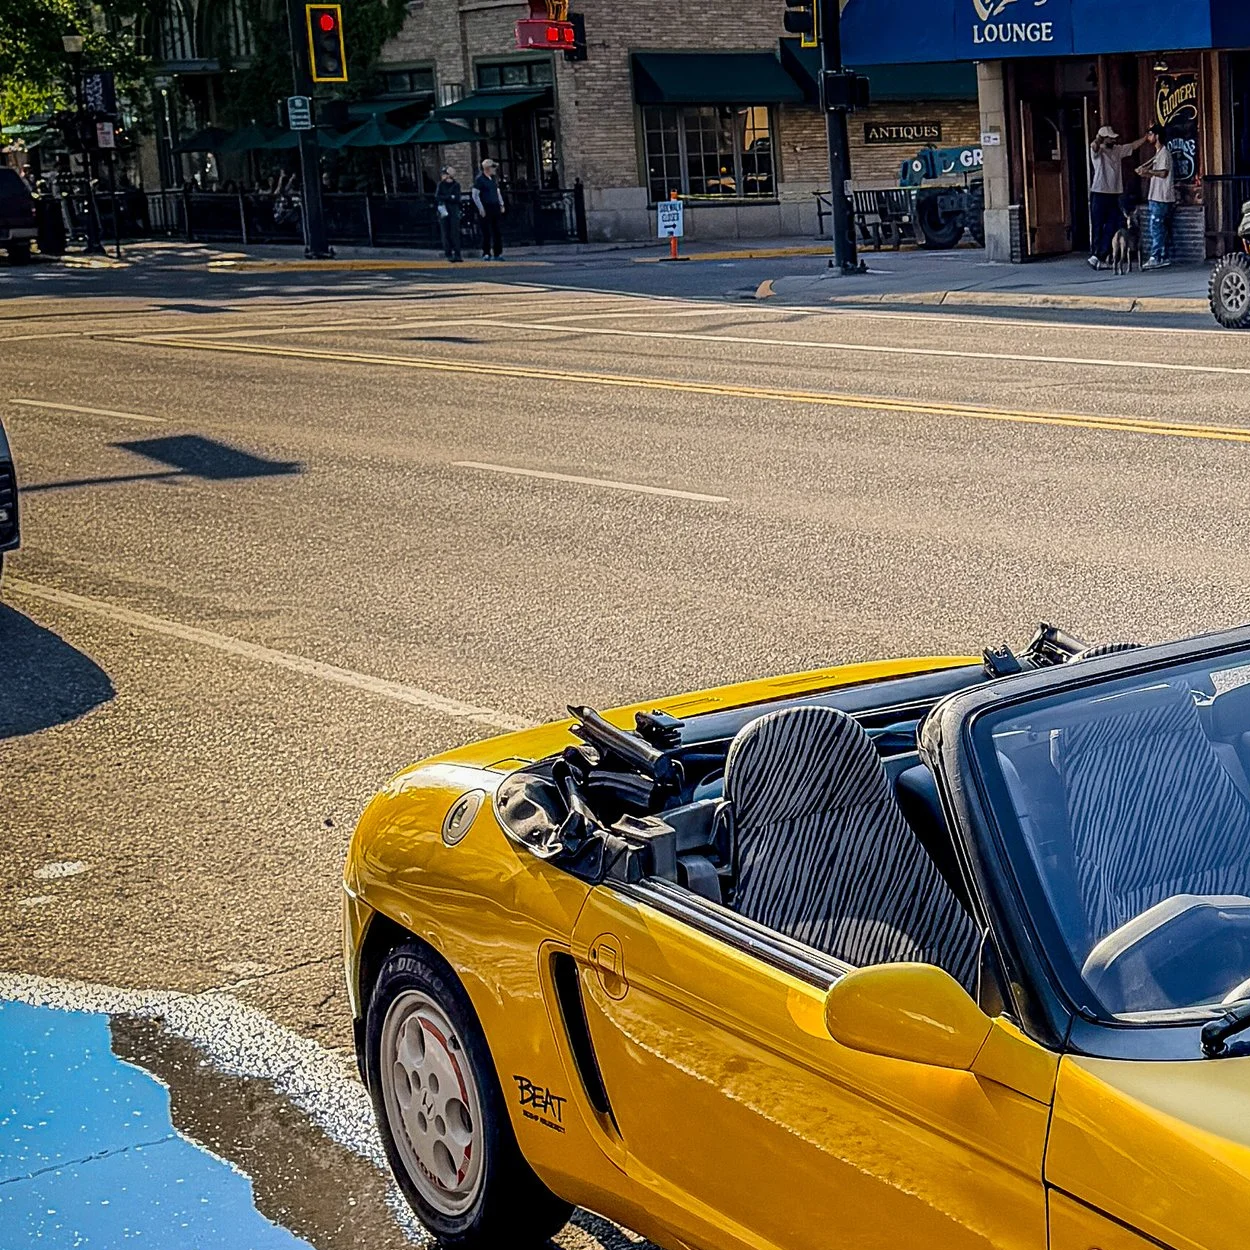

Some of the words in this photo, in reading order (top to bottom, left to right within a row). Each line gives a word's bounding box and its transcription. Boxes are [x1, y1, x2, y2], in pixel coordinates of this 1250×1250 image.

[973, 22, 1054, 43] LOUNGE
[869, 126, 939, 140] ANTIQUES
[513, 1075, 567, 1122] BEAT
